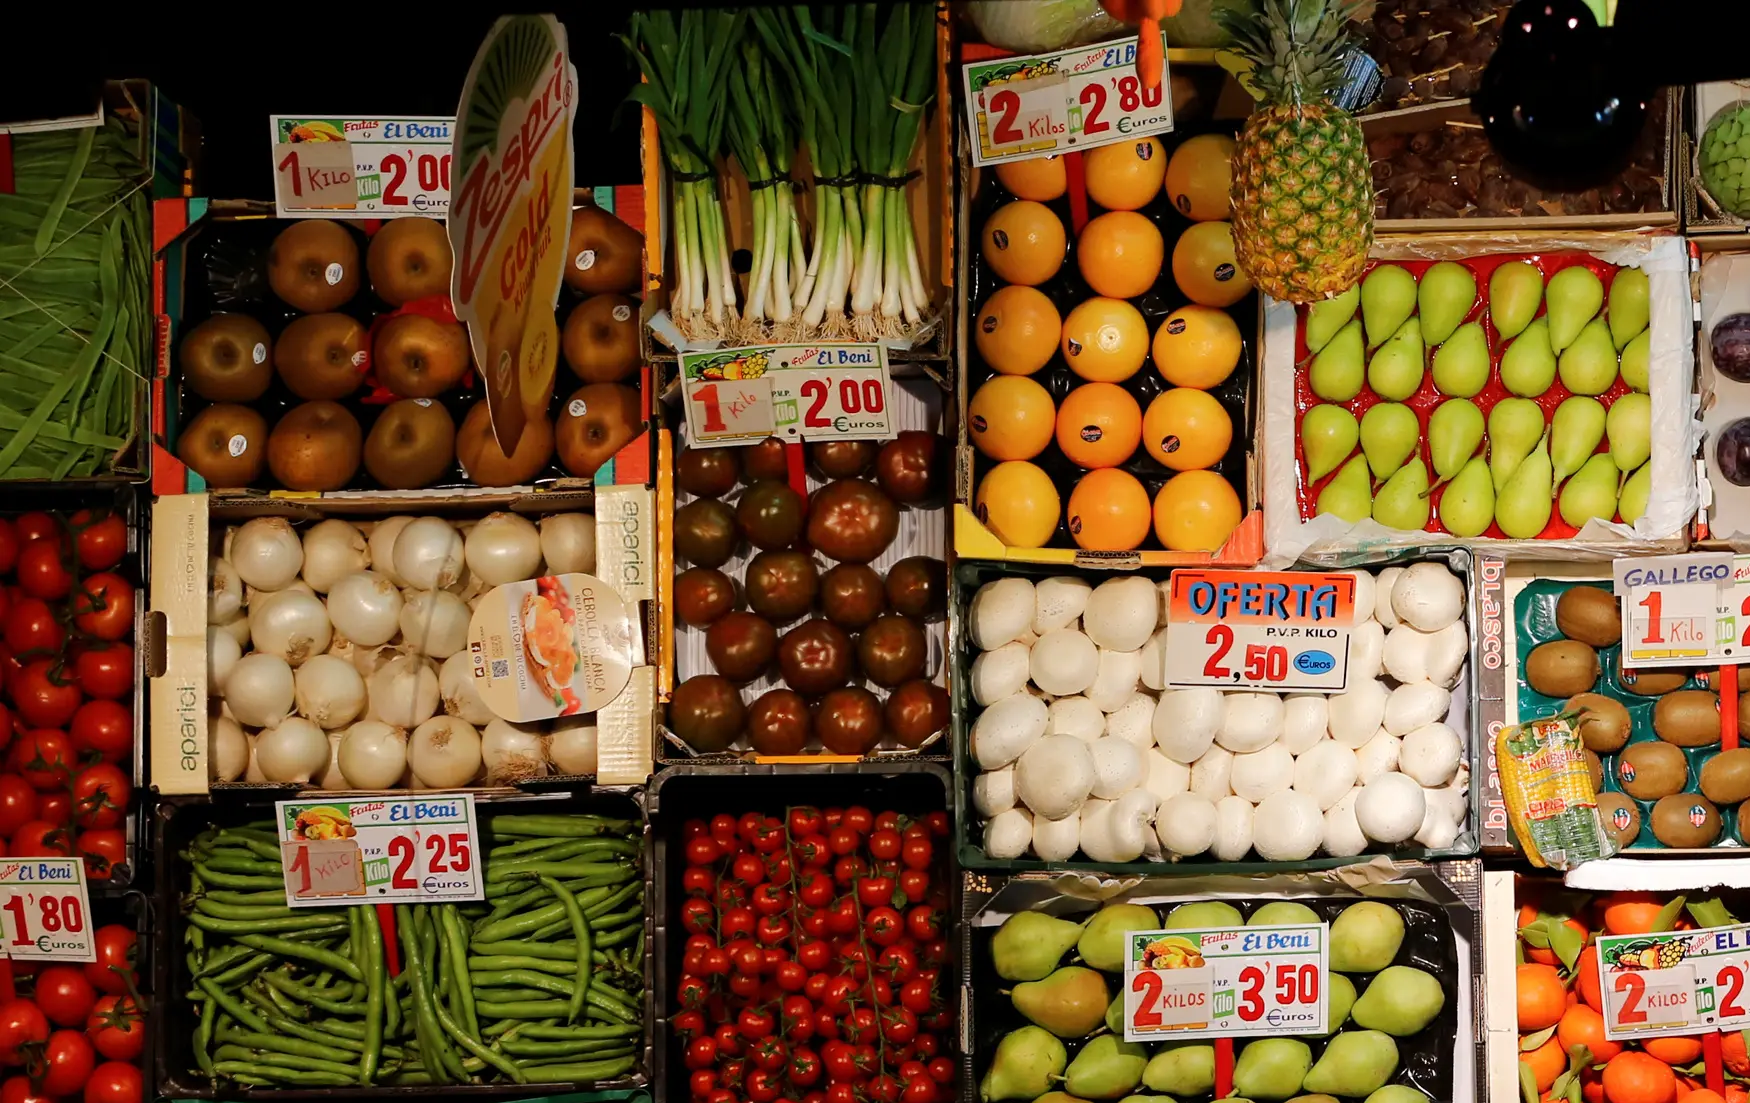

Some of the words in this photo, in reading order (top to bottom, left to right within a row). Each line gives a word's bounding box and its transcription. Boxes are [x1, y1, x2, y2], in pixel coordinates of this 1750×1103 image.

[384, 124, 404, 139] El
[407, 122, 450, 139] Beni
[989, 90, 1024, 145] 2
[1029, 119, 1066, 138] Kilos
[278, 151, 302, 198] 1
[455, 51, 566, 306] Zespri
[818, 350, 836, 365] El
[840, 349, 874, 364] Beni
[693, 384, 728, 434] 1
[801, 378, 885, 429] 2'00
[623, 499, 643, 588] aparici
[1188, 580, 1338, 622] OFERTA
[1623, 564, 1731, 587] GALLEGO
[1306, 627, 1338, 639] KILO
[1639, 591, 1665, 644] 1
[1203, 624, 1289, 683] 2,50
[179, 684, 201, 772] aparici
[390, 805, 413, 821] El
[416, 803, 461, 819] Beni
[18, 866, 38, 880] El
[40, 863, 73, 880] Beni
[289, 846, 313, 894] 1
[389, 831, 471, 890] 2'25
[3, 894, 82, 946] 1'80
[1716, 933, 1740, 950] EL
[1131, 971, 1163, 1027] 2
[1238, 961, 1318, 1022] 3'50
[1614, 973, 1648, 1024] 2
